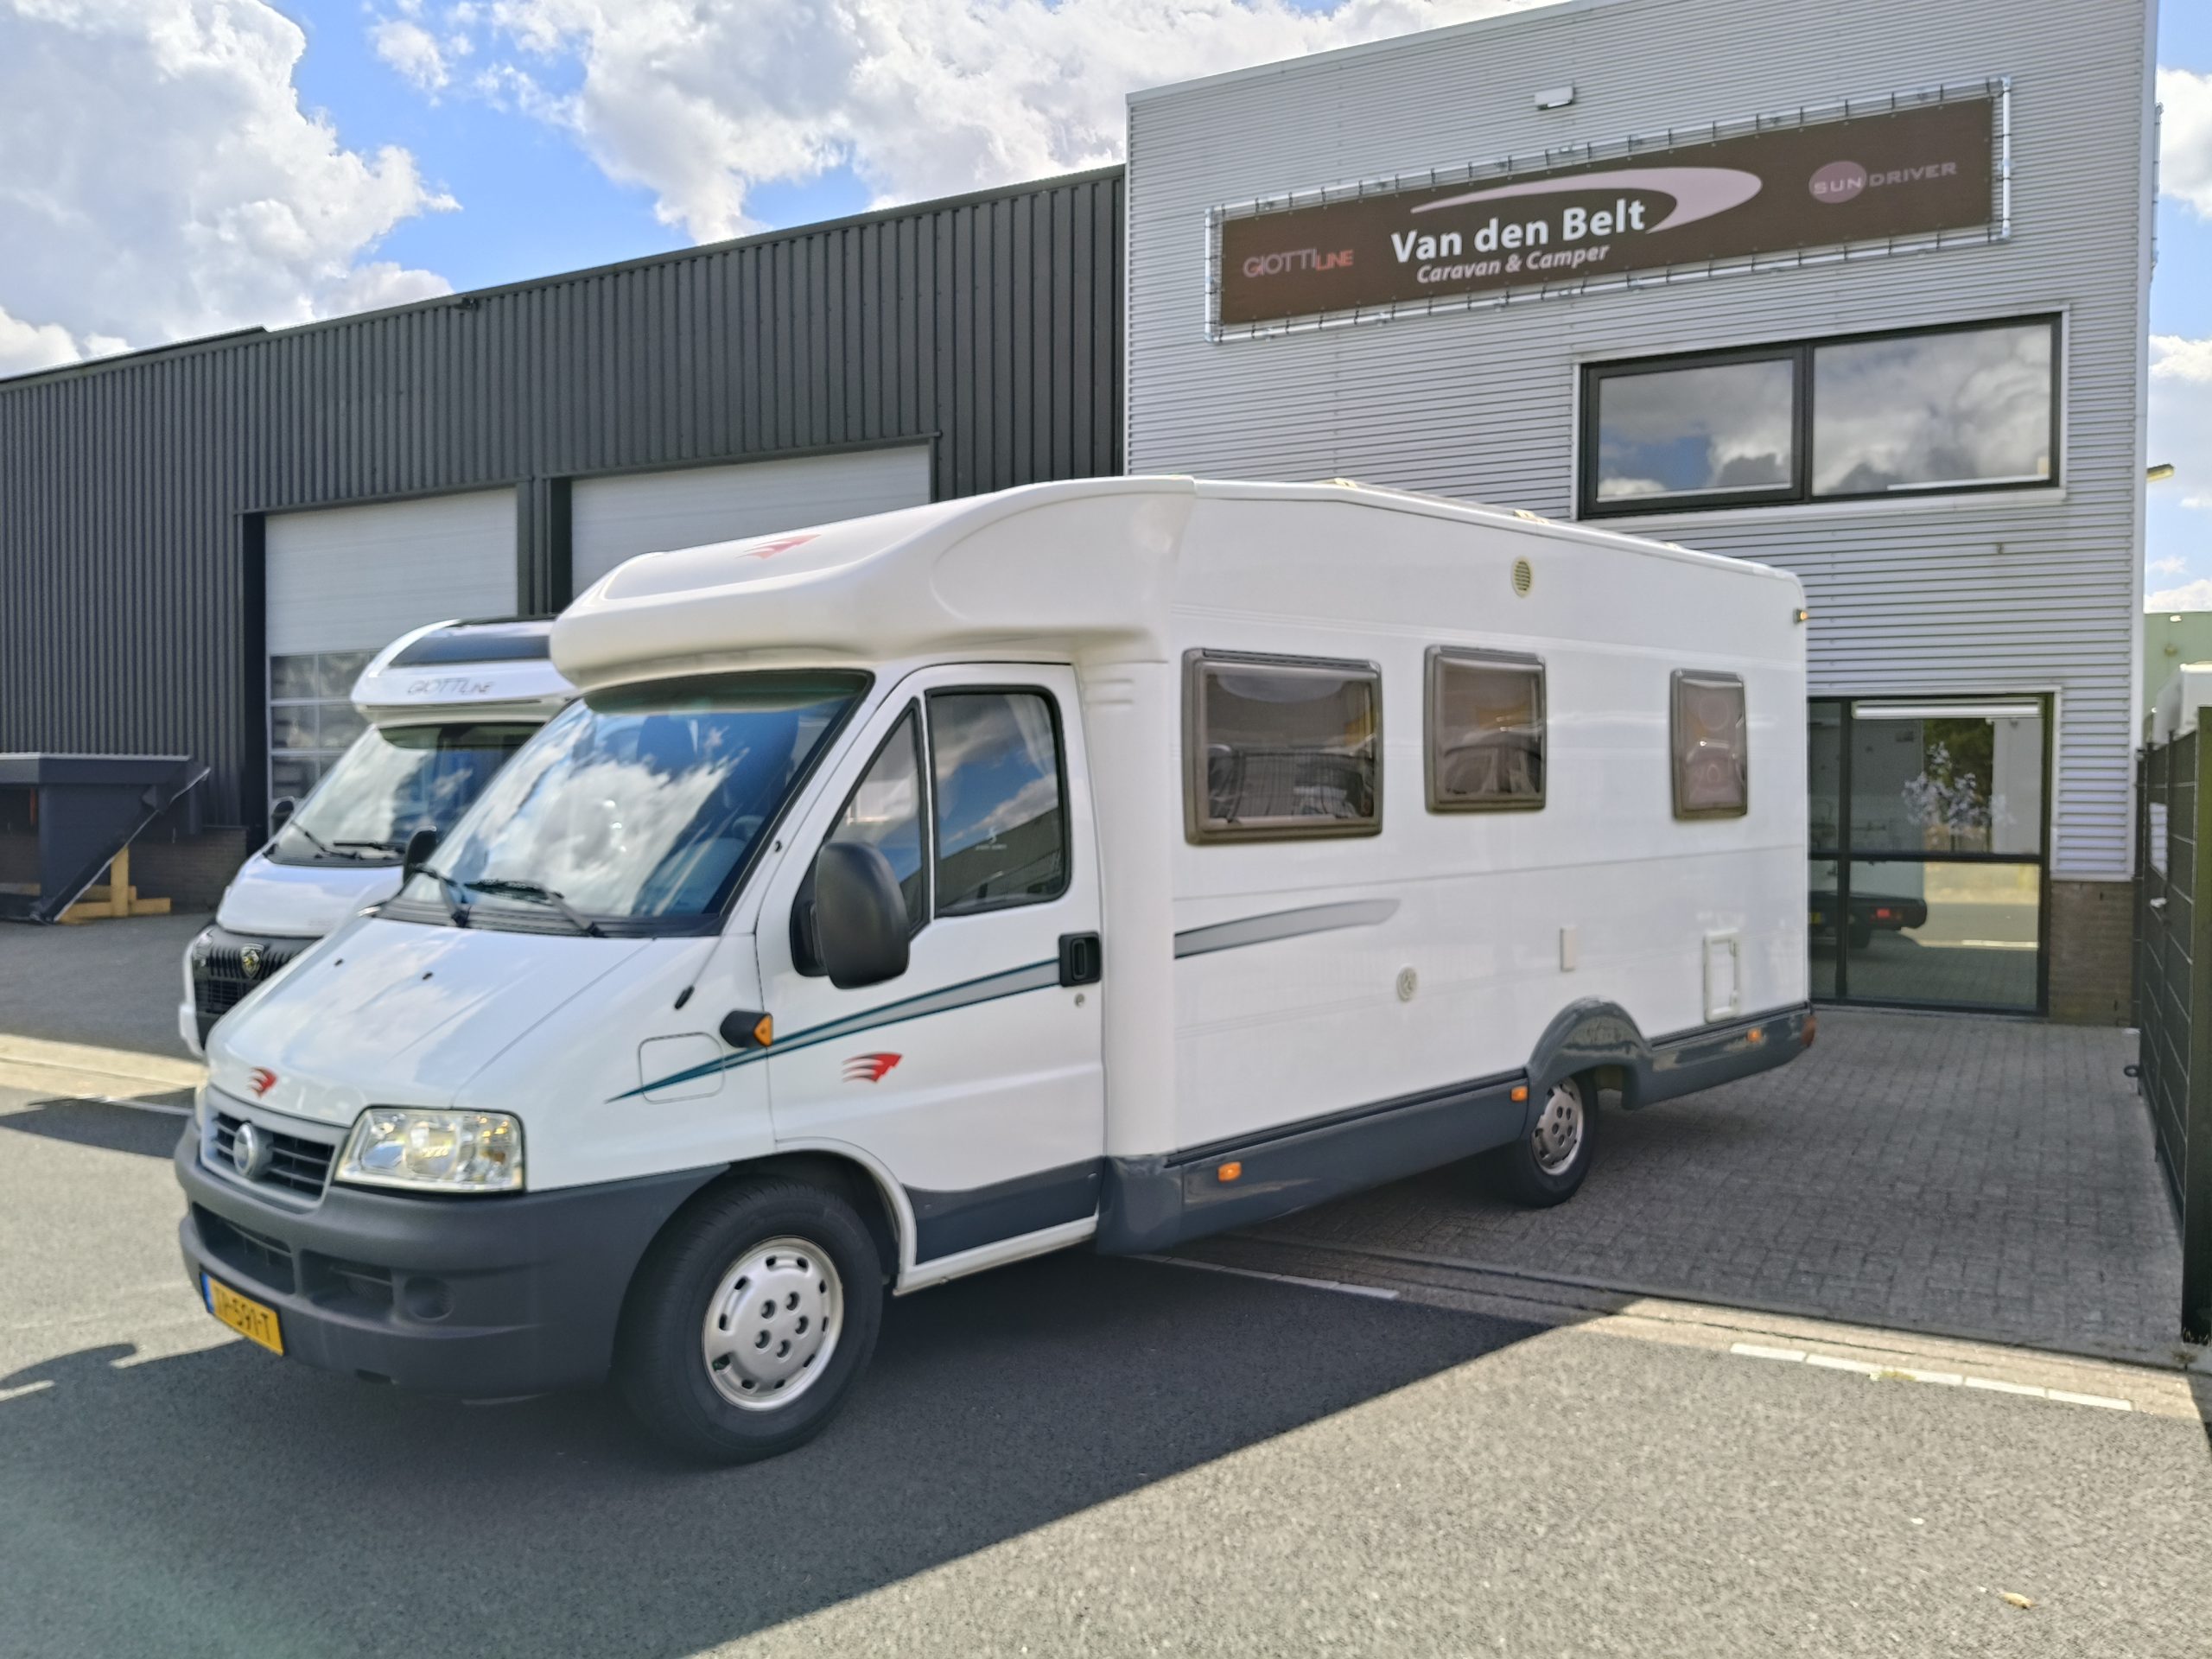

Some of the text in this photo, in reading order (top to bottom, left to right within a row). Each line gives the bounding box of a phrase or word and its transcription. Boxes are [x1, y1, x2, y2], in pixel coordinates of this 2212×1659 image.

[1390, 198, 1646, 263] Van den Belt
[1416, 244, 1611, 283] Caravan & Camper
